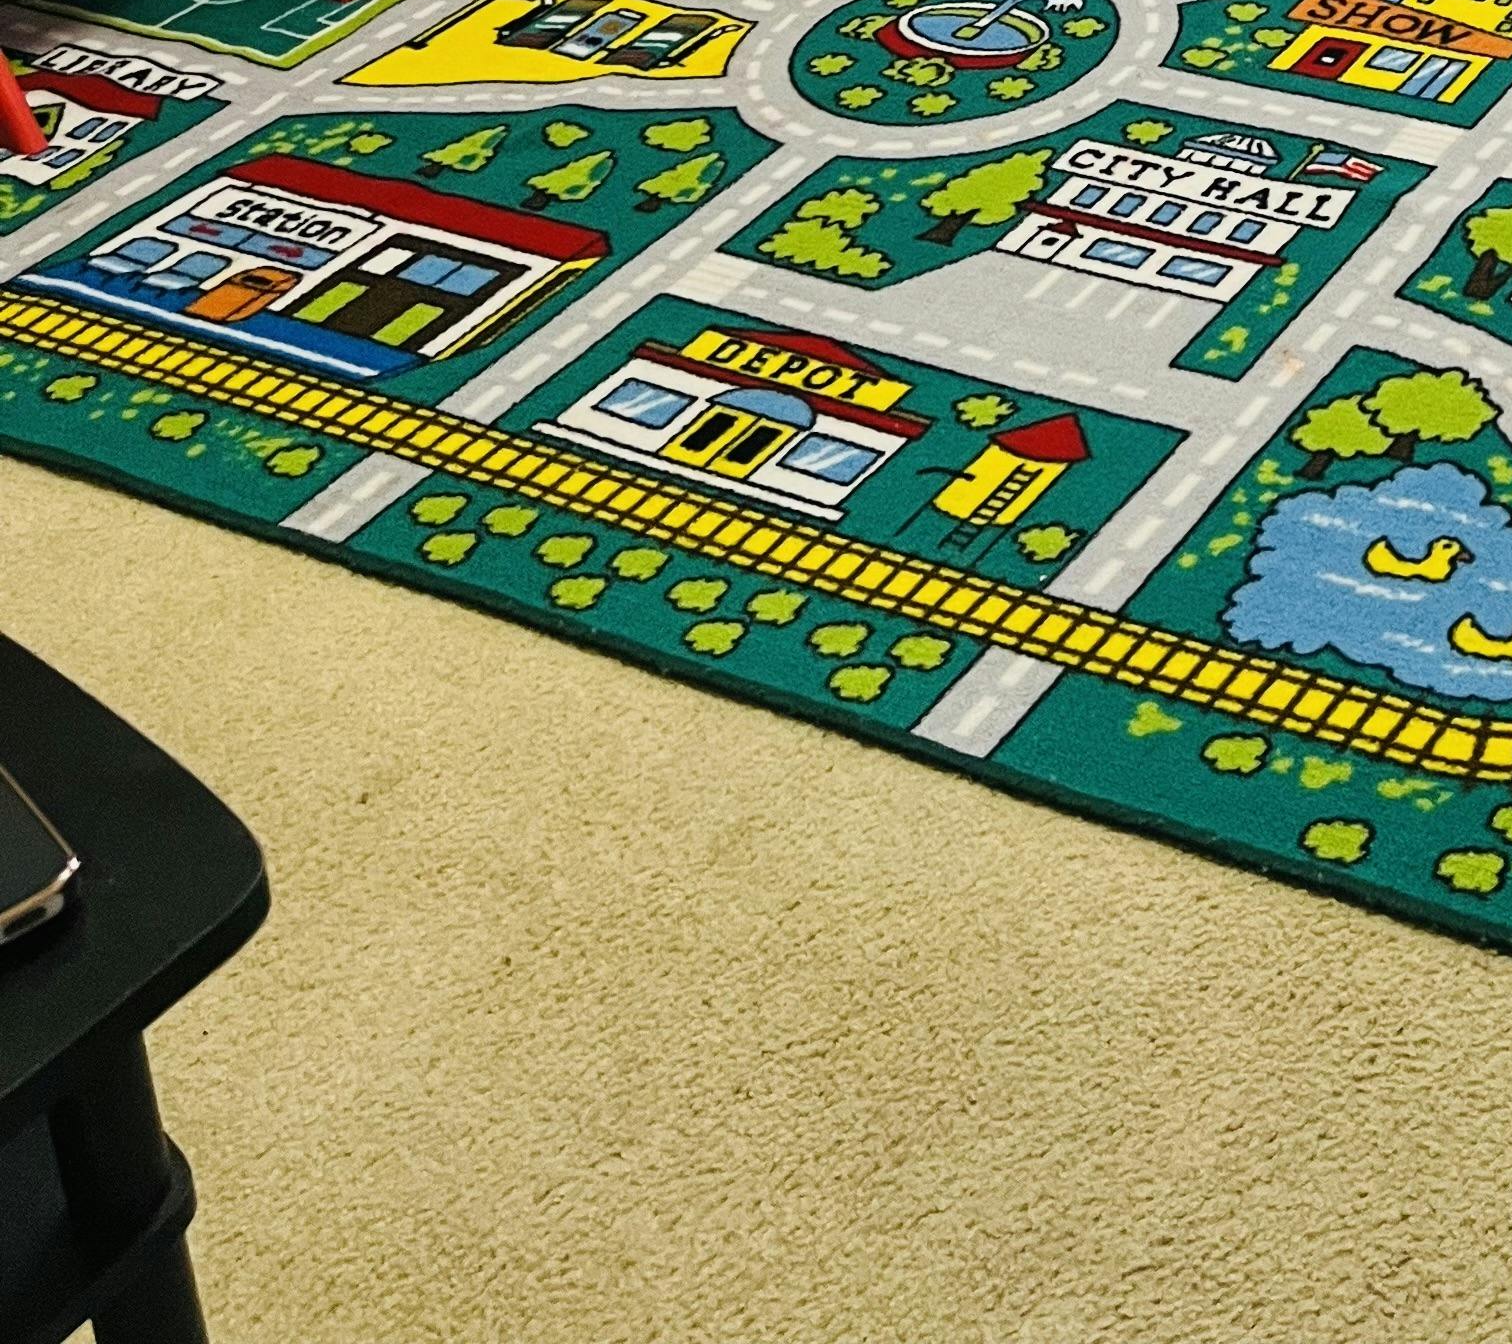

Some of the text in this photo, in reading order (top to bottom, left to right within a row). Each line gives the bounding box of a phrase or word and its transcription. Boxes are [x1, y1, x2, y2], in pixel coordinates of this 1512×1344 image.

[41, 48, 205, 102] LIBRARY
[1068, 148, 1336, 223] CITY HALL
[224, 196, 351, 245] station
[705, 339, 886, 404] DEPOT
